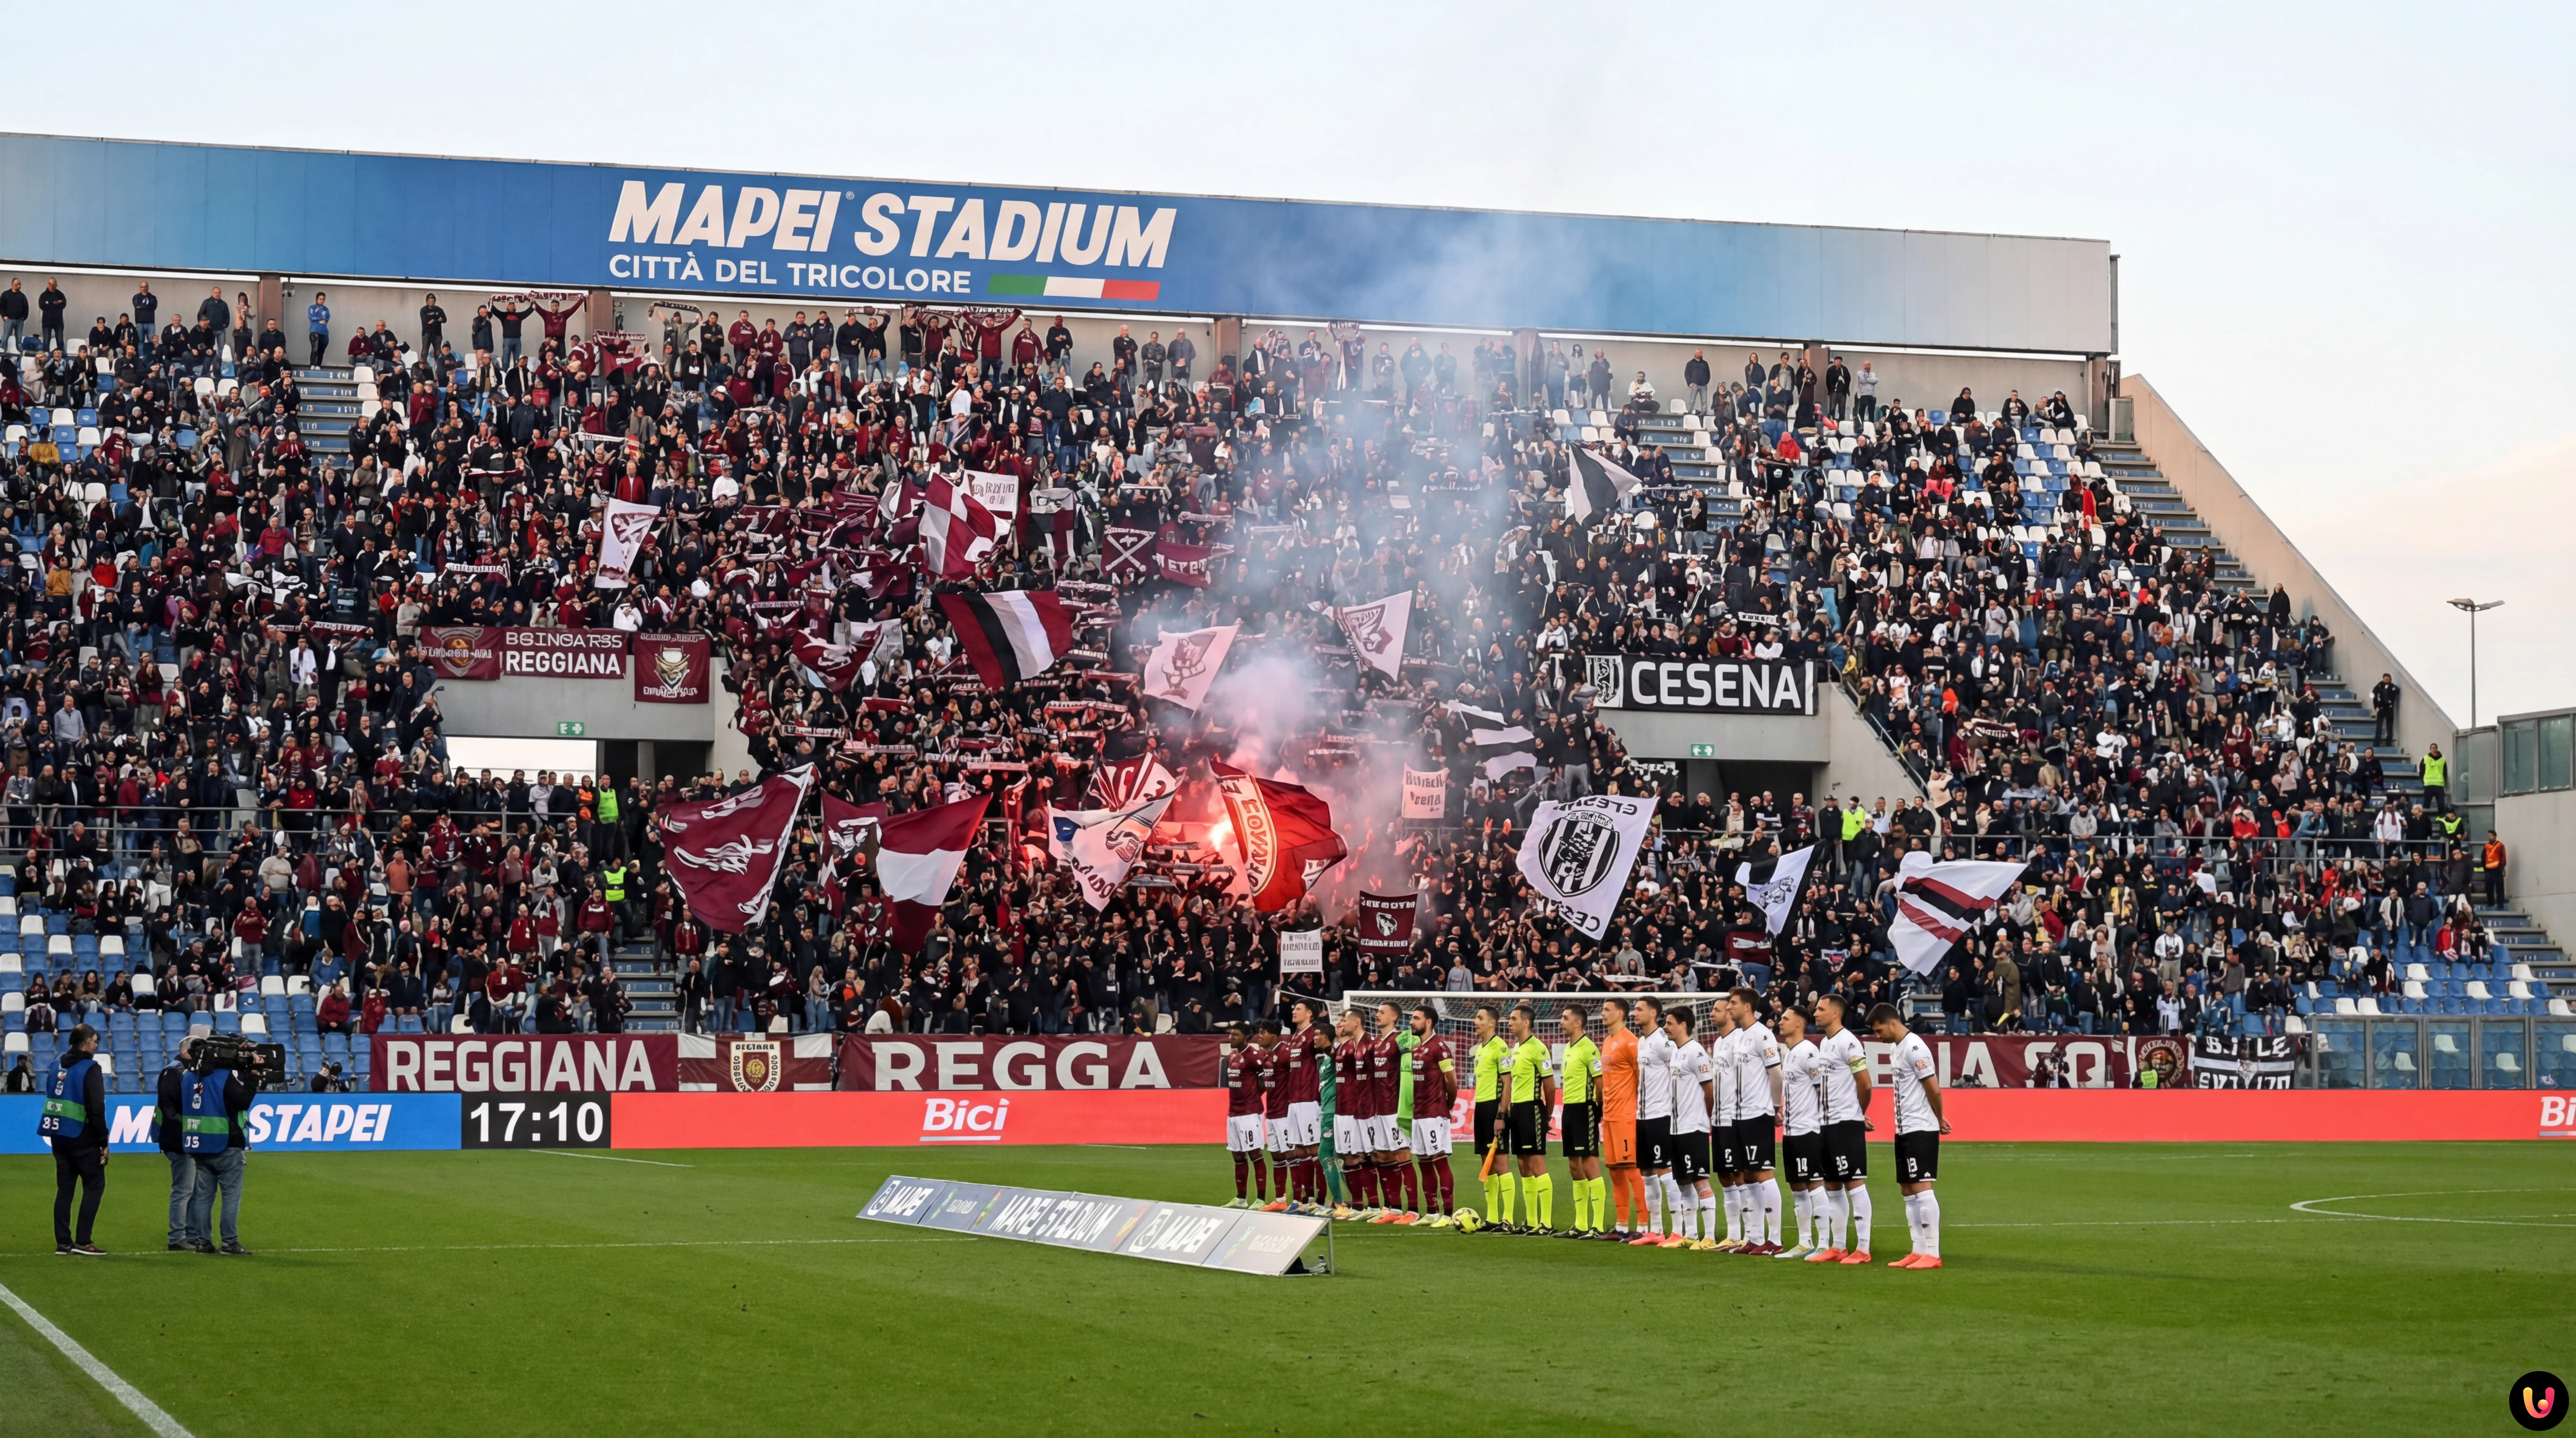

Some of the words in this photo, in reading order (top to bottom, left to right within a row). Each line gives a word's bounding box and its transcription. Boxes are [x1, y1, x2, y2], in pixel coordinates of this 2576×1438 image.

[608, 180, 842, 252] MAPEI
[854, 192, 1178, 268] STADIUM
[609, 251, 704, 281] CITTÀ
[716, 259, 777, 285] DEL
[787, 263, 971, 293] TRICOLORE
[506, 651, 621, 675] REGGIANA
[1631, 660, 1802, 709] CESENA
[387, 1040, 656, 1092] REGGIANA
[871, 1041, 1172, 1091] REGGA
[249, 1104, 392, 1143] STAPEI
[470, 1102, 604, 1142] 17:10
[1430, 1130, 1437, 1144] 9
[1623, 1139, 1628, 1152] 1
[1654, 1145, 1661, 1159] 9
